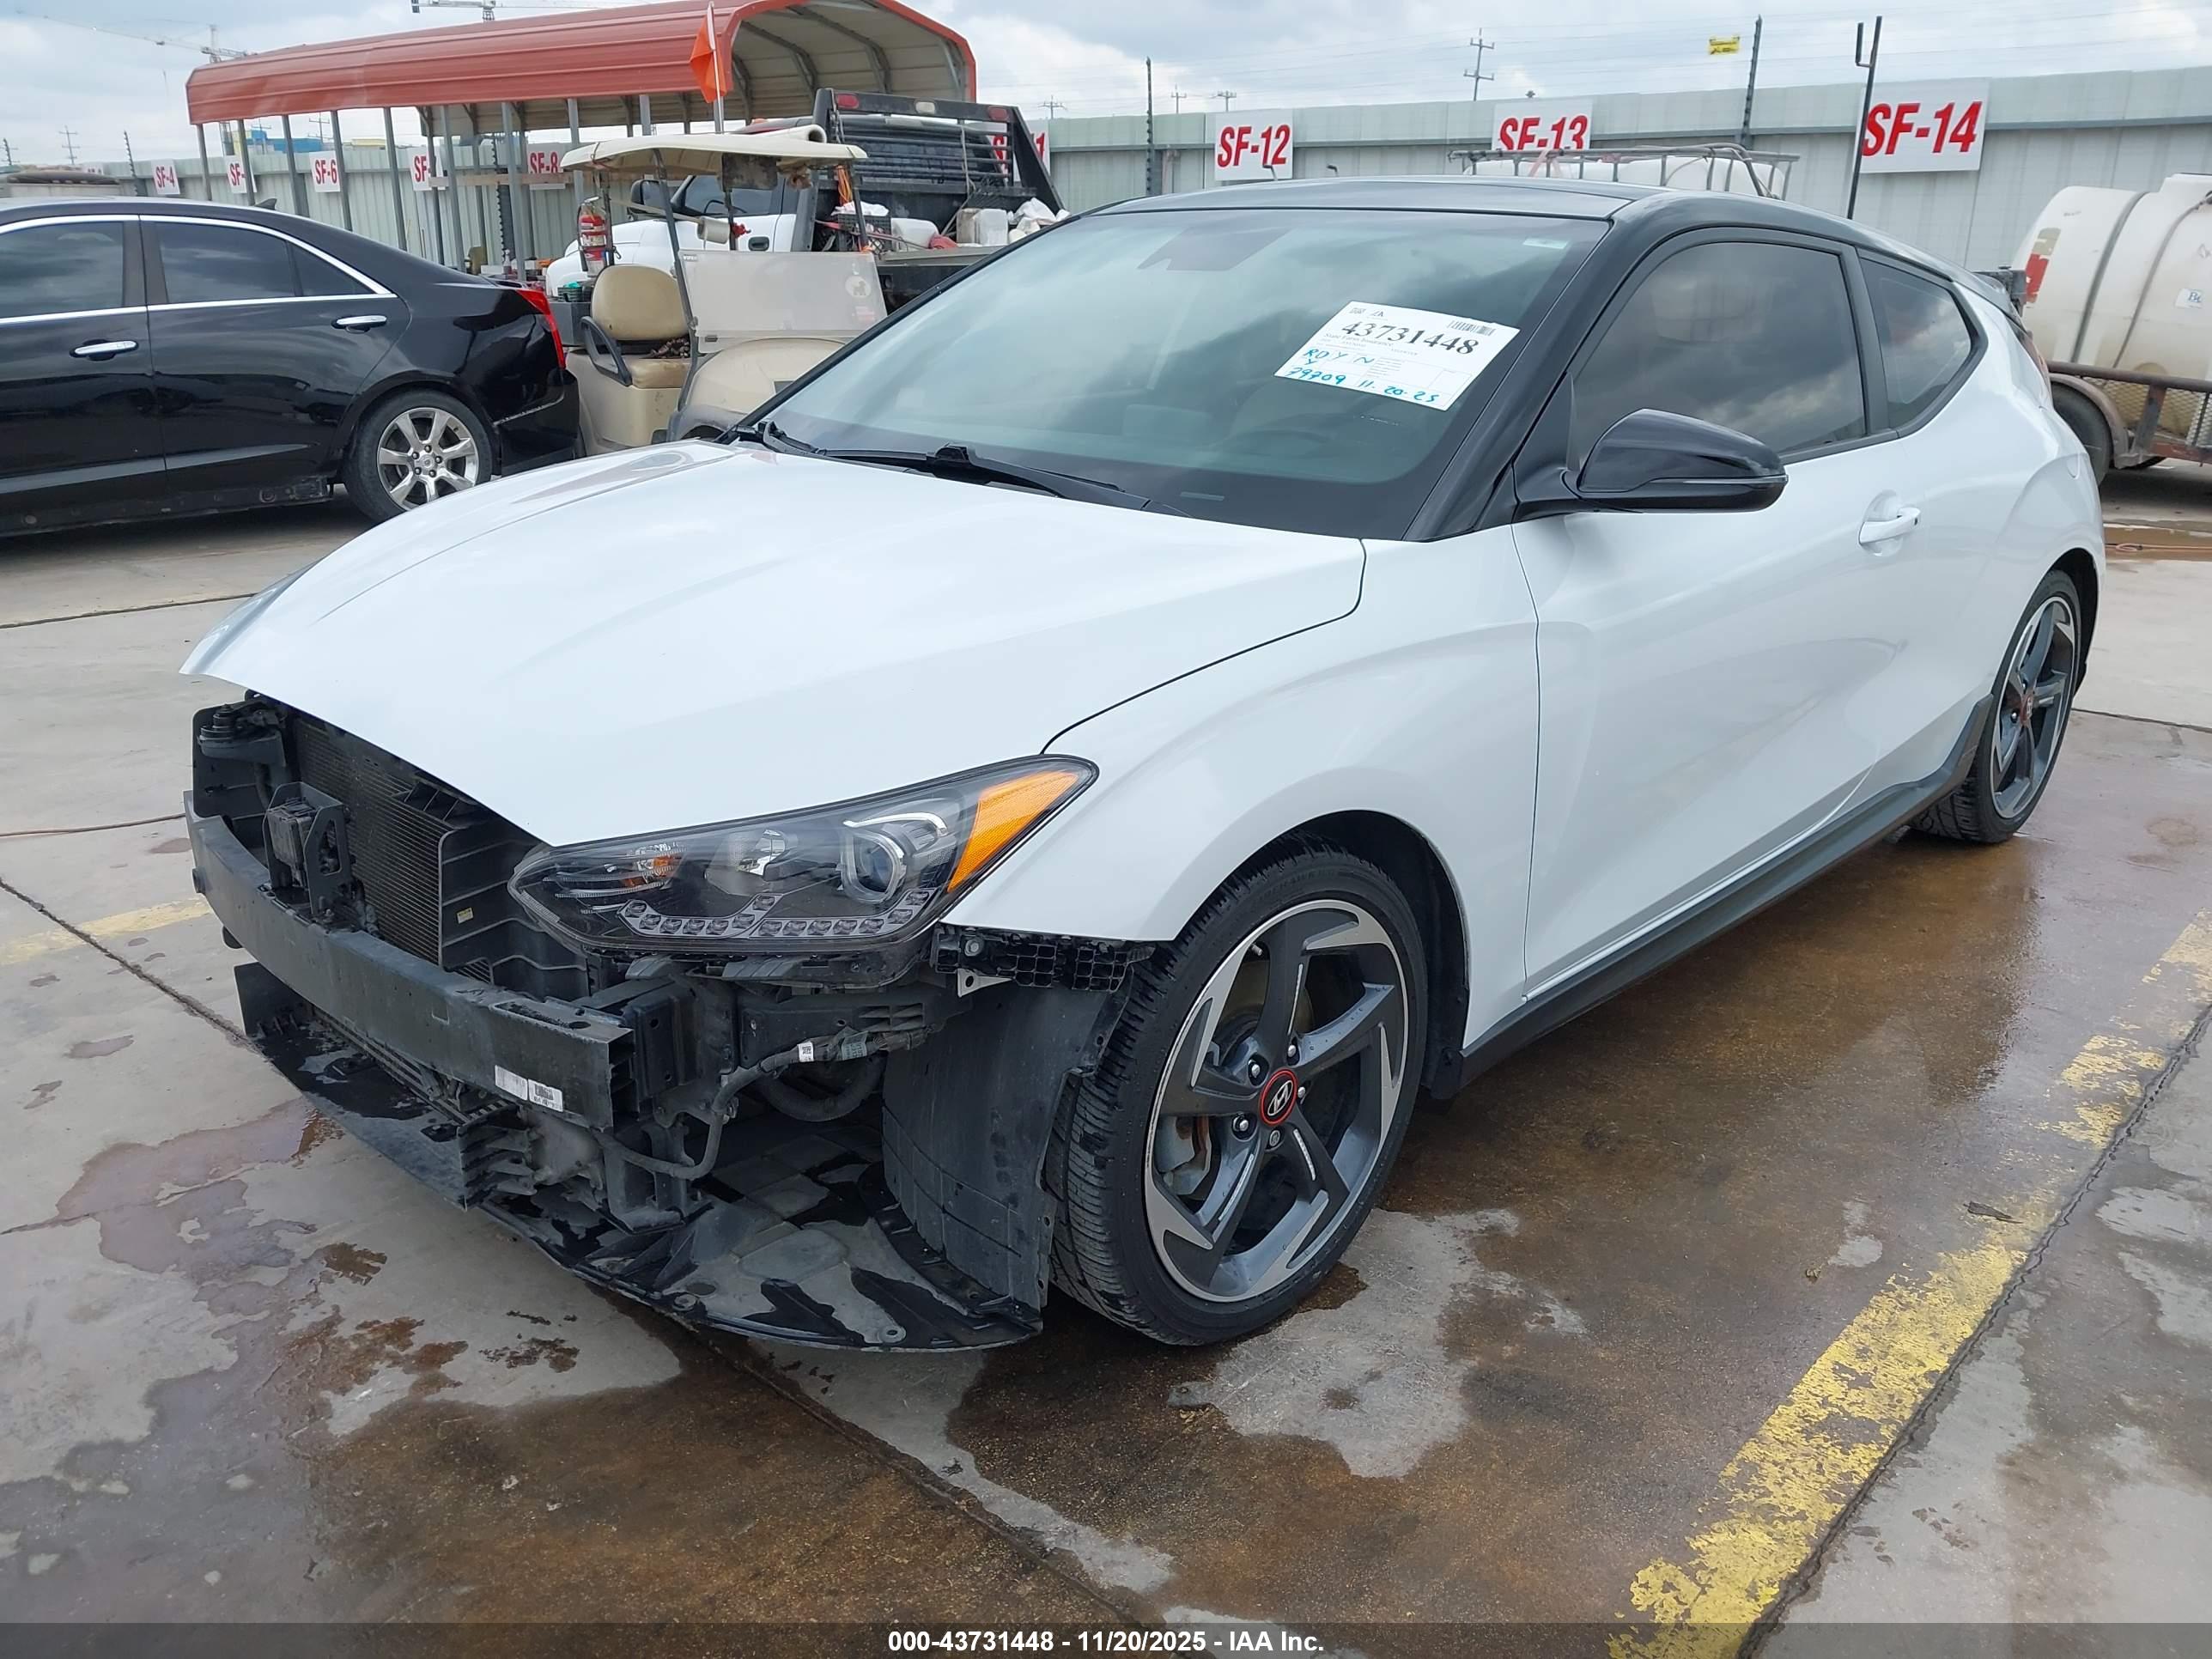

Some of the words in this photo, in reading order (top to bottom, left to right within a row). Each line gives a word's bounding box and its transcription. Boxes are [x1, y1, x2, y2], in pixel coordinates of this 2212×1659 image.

[1499, 115, 1589, 150] SF-13
[1862, 100, 1983, 156] SF-14
[1217, 124, 1291, 168] SF-12
[229, 162, 246, 186] SF-
[314, 158, 337, 185] SF-6
[414, 155, 431, 182] SF-
[530, 151, 559, 173] SF-8
[155, 165, 175, 188] SF-4
[1341, 320, 1480, 355] 43731448
